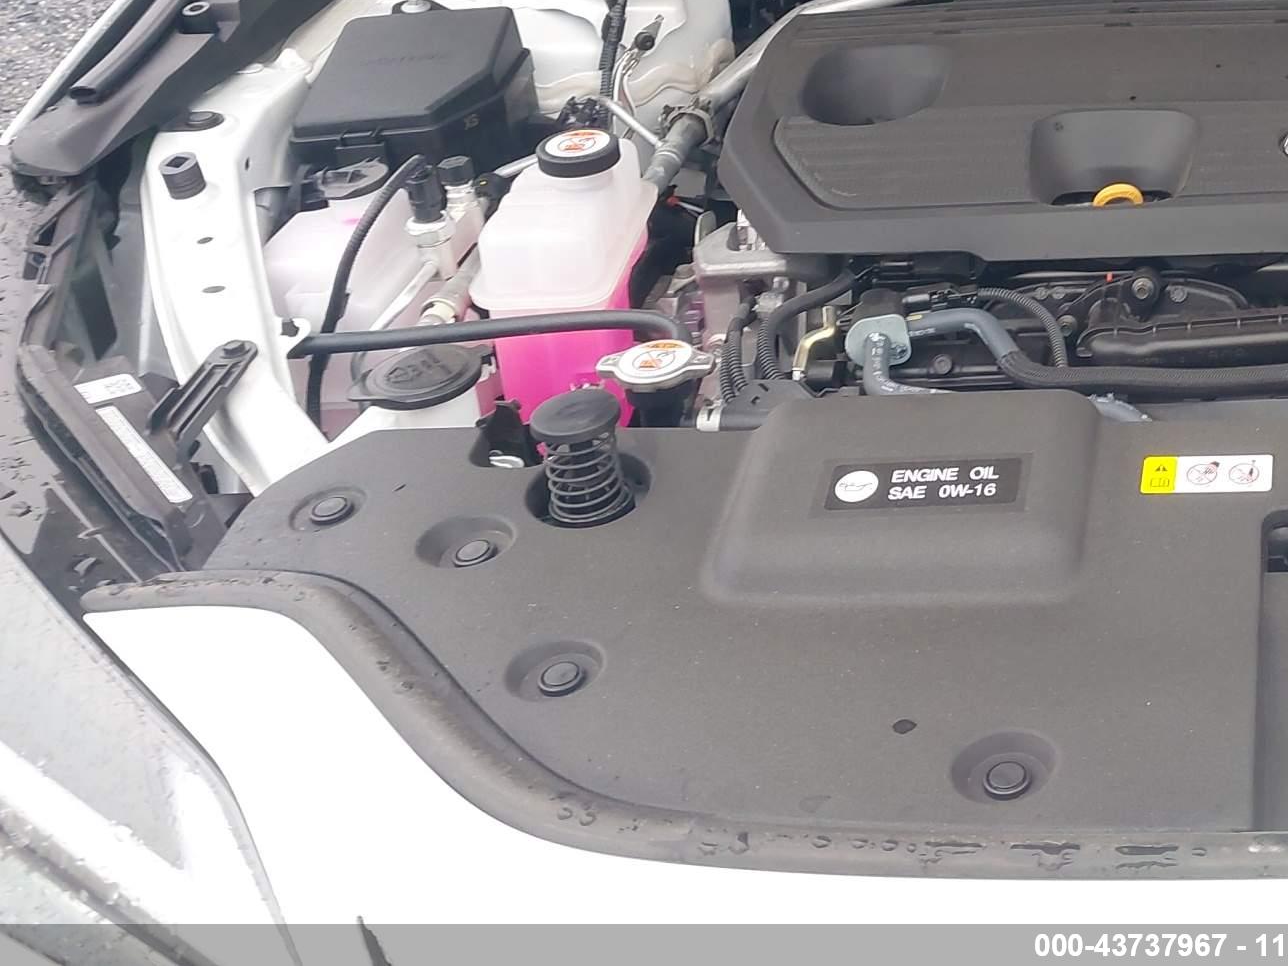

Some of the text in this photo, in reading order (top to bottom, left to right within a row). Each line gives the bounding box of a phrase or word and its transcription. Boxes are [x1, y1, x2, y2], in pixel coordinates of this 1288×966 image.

[890, 465, 1000, 483] ENGINE OIL
[887, 482, 997, 500] SAE 0W-16
